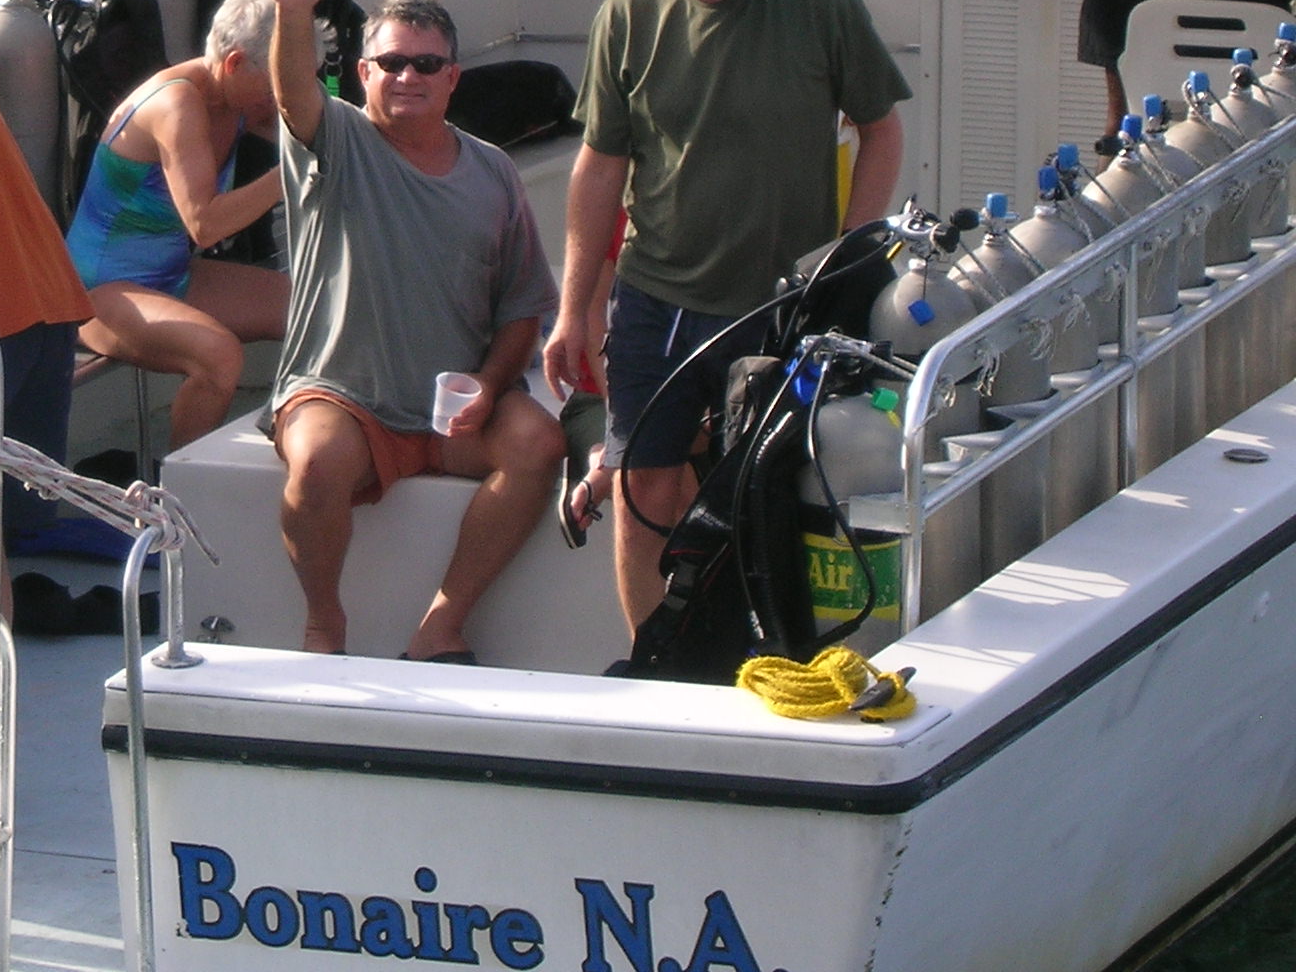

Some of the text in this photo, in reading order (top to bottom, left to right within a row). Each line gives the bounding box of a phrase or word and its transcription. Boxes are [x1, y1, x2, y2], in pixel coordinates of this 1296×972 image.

[808, 552, 853, 591] Air
[170, 842, 790, 972] Bonaire N.A
